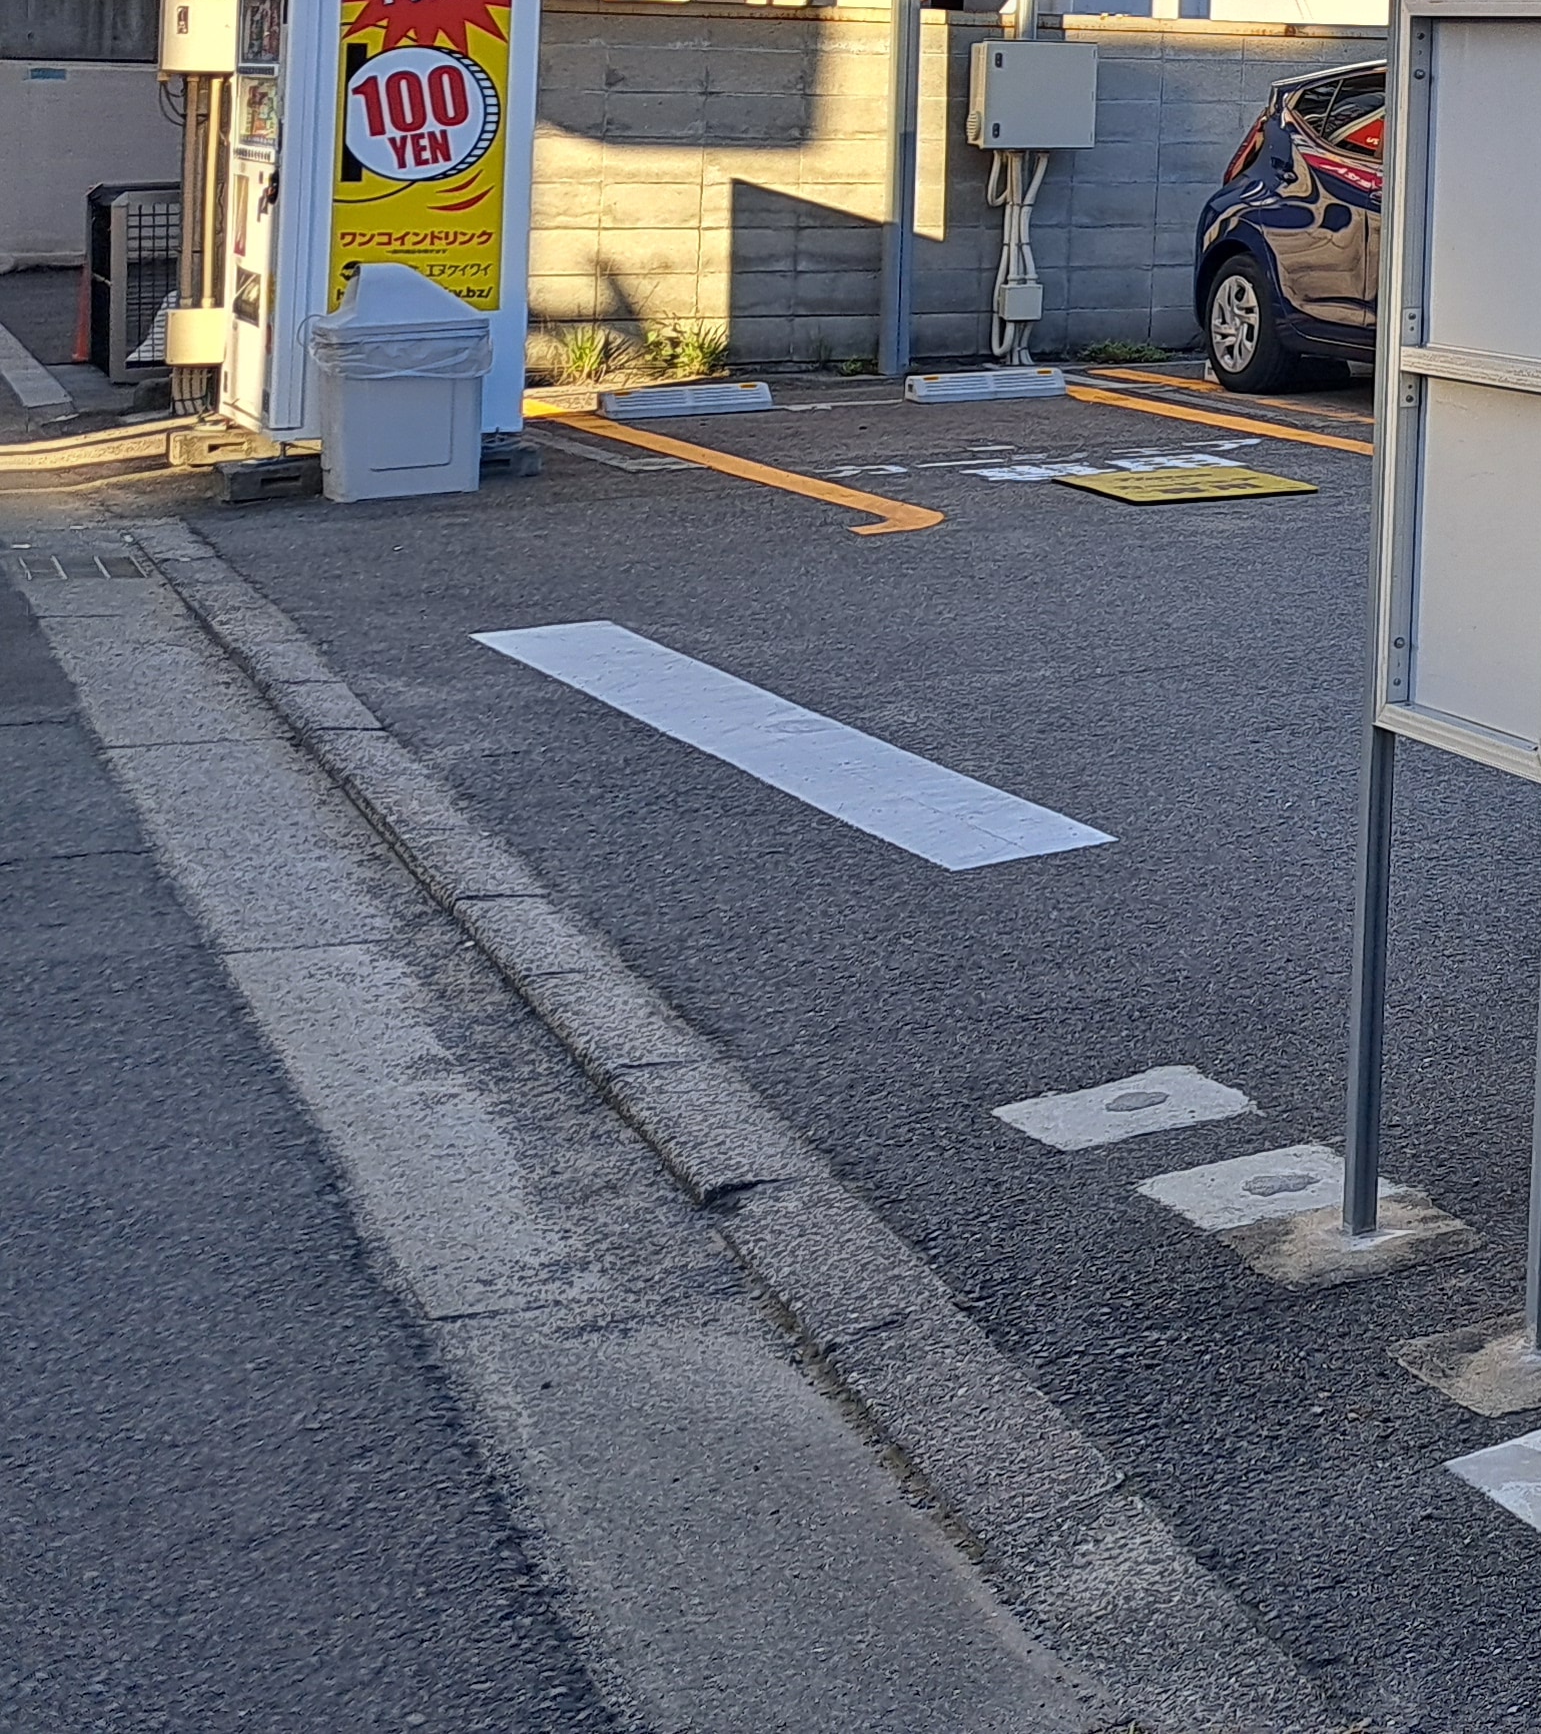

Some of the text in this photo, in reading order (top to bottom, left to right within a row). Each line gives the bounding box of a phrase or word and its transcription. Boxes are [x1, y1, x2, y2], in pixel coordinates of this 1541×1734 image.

[351, 64, 470, 137] 100
[388, 128, 452, 169] YEN
[339, 229, 494, 248] ワンコインドリンク
